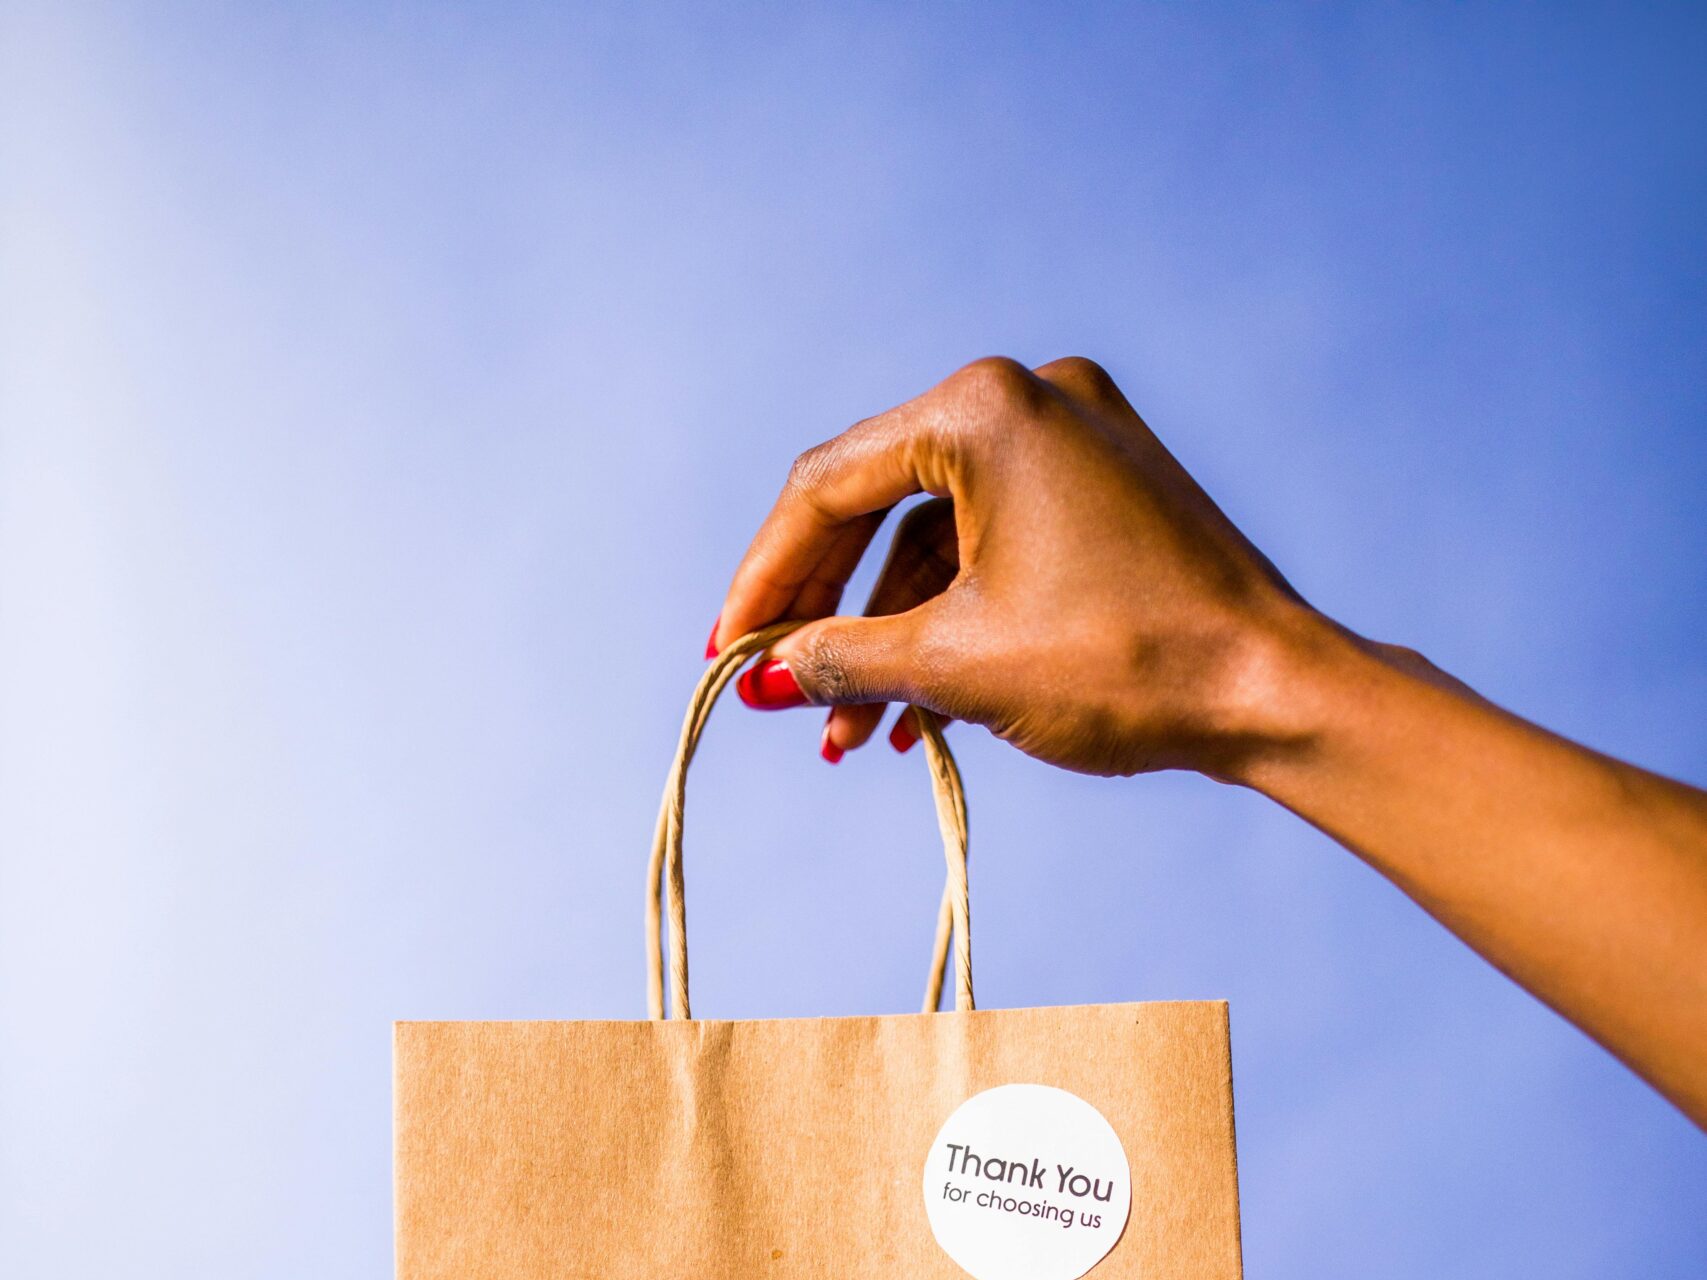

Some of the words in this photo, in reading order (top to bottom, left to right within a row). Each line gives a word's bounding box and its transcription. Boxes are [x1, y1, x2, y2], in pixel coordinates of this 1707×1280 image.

[946, 1143, 1047, 1189] Thank
[1056, 1164, 1114, 1202] You
[943, 1182, 972, 1203] for
[976, 1190, 1075, 1229] choosing
[1080, 1212, 1102, 1229] us
